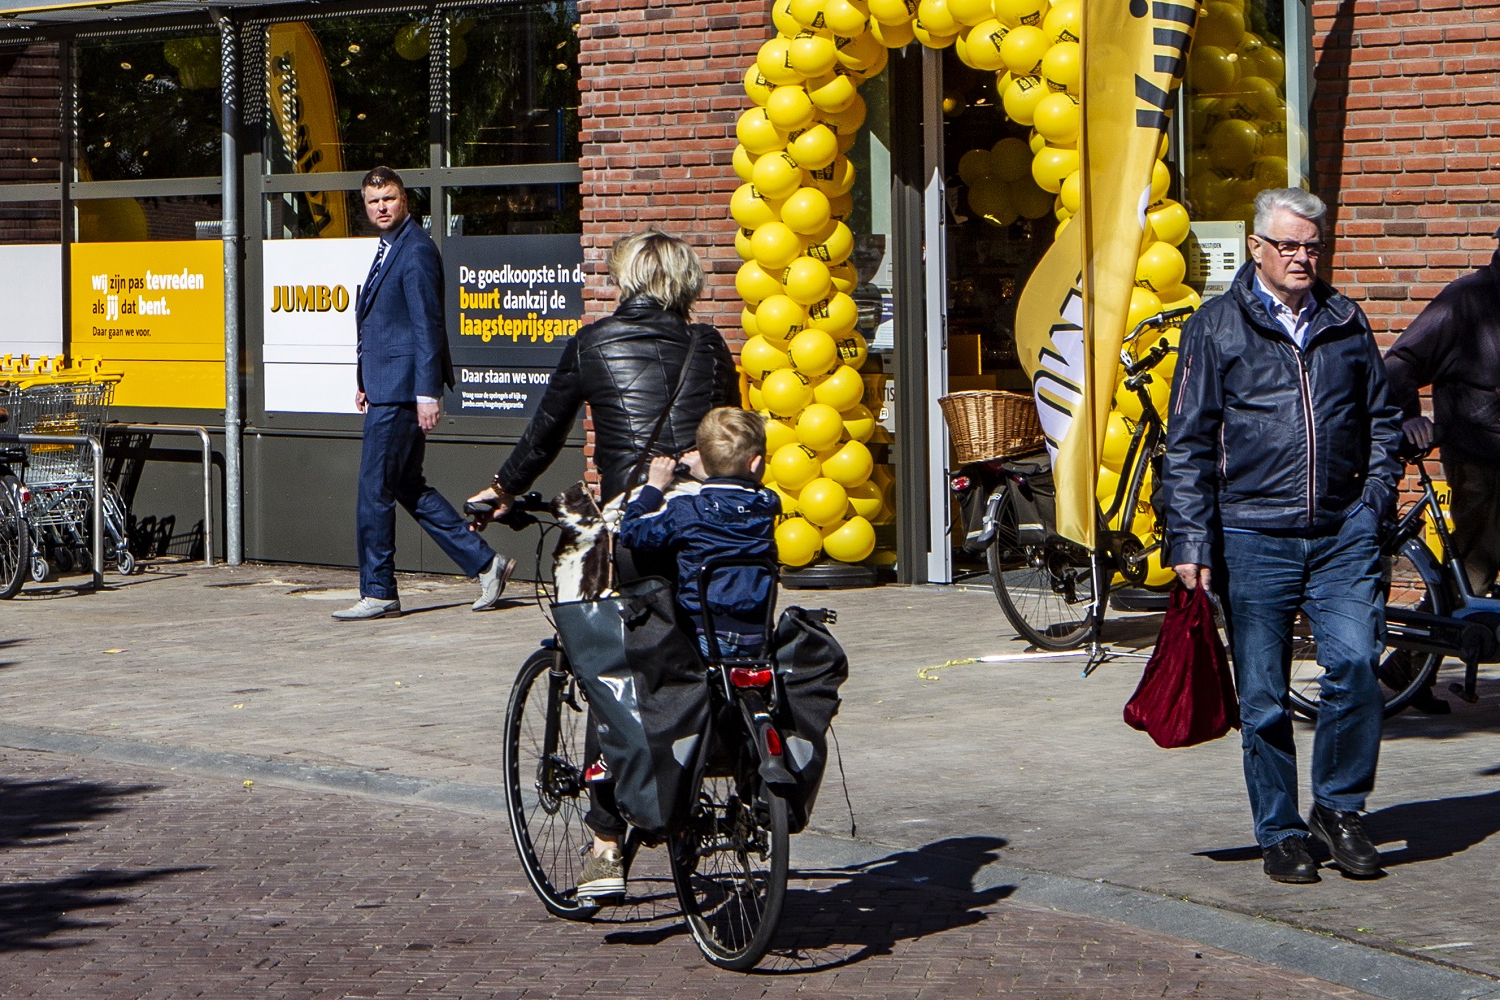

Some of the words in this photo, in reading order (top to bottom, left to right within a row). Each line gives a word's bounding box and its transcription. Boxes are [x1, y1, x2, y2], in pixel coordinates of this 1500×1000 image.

[110, 274, 126, 294] zijn
[129, 277, 144, 293] pas
[145, 268, 204, 290] tevreden
[460, 265, 476, 284] De
[478, 264, 555, 289] goedkoopste
[557, 264, 570, 283] in
[92, 299, 105, 314] als
[106, 295, 118, 321] jij
[121, 299, 137, 314] dat
[138, 295, 170, 316] bent.
[270, 284, 350, 313] JUMBO
[460, 286, 501, 309] buurt
[503, 290, 548, 315] dankzij
[550, 290, 566, 309] de
[92, 326, 107, 336] Daar
[108, 329, 124, 339] gaan
[136, 329, 151, 337] voor.
[461, 368, 484, 383] Daar
[484, 369, 511, 384] staan
[512, 372, 527, 384] we
